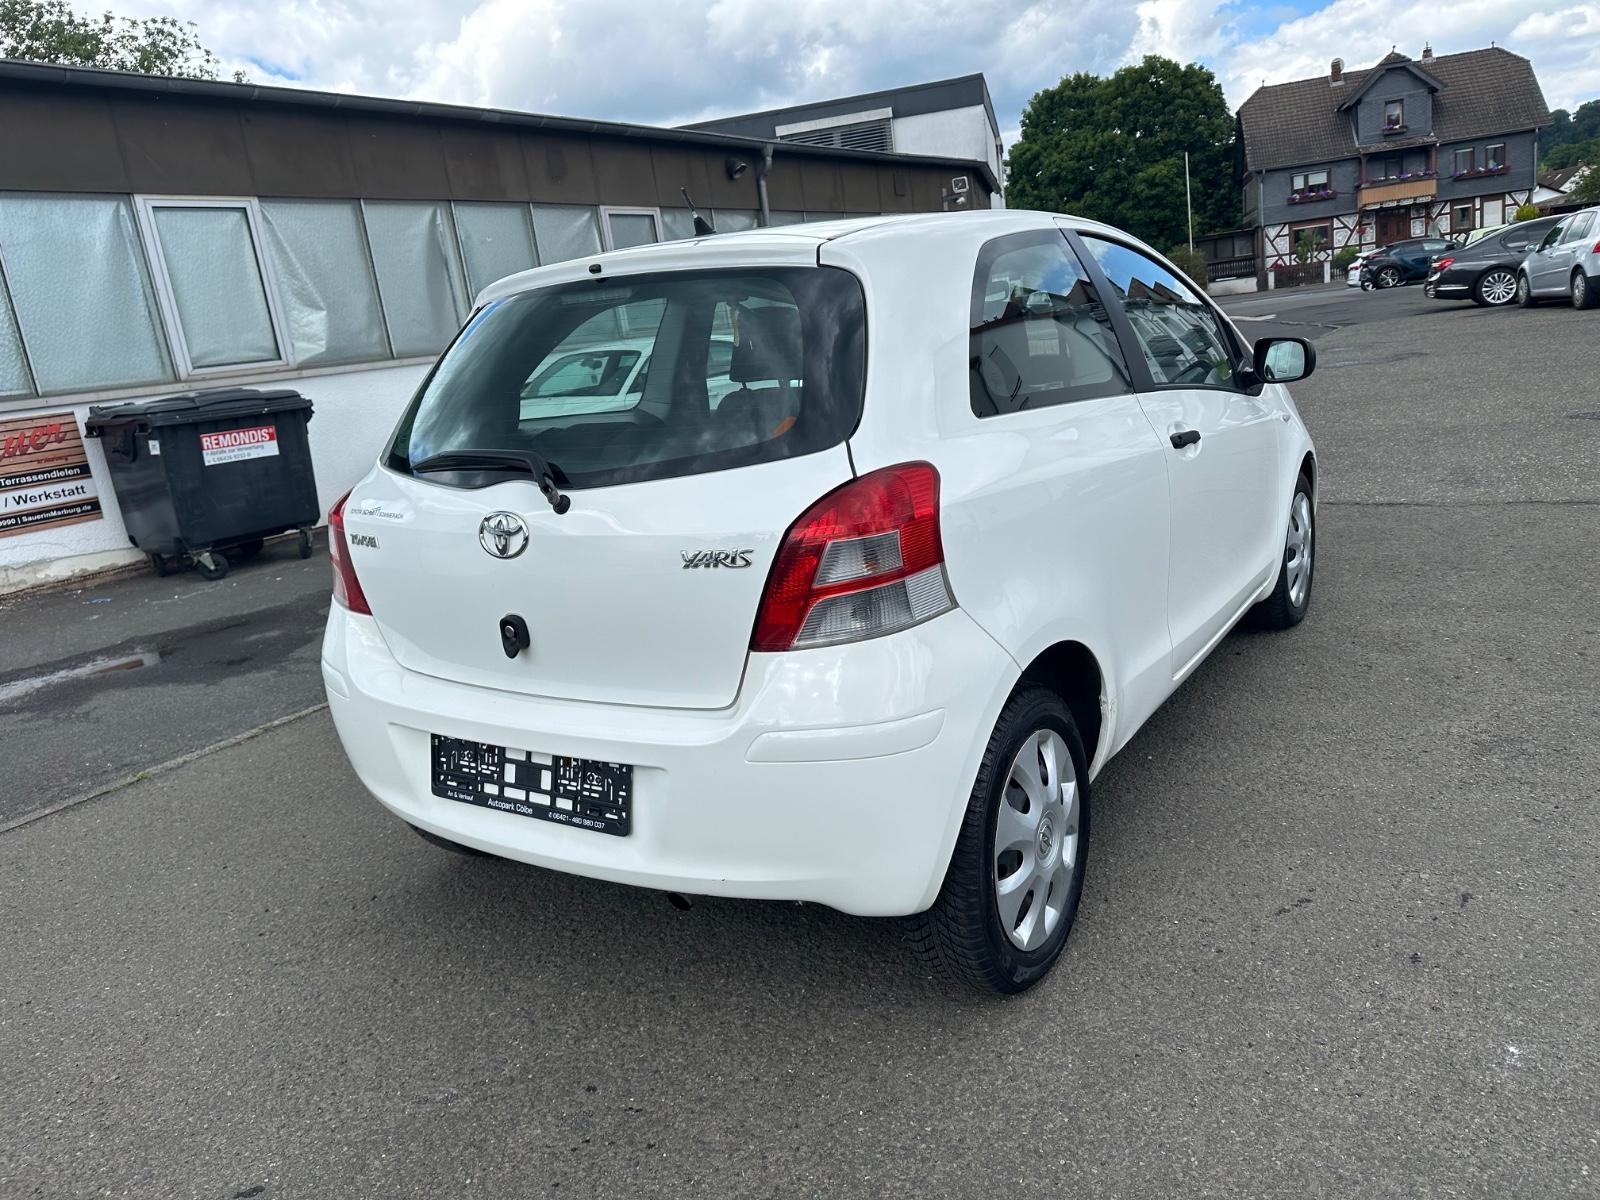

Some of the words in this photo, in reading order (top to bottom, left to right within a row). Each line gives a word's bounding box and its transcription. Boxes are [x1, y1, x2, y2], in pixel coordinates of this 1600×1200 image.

[0, 467, 80, 487] Terrassendielen
[12, 485, 87, 506] Werkstatt
[487, 797, 515, 811] Autopark
